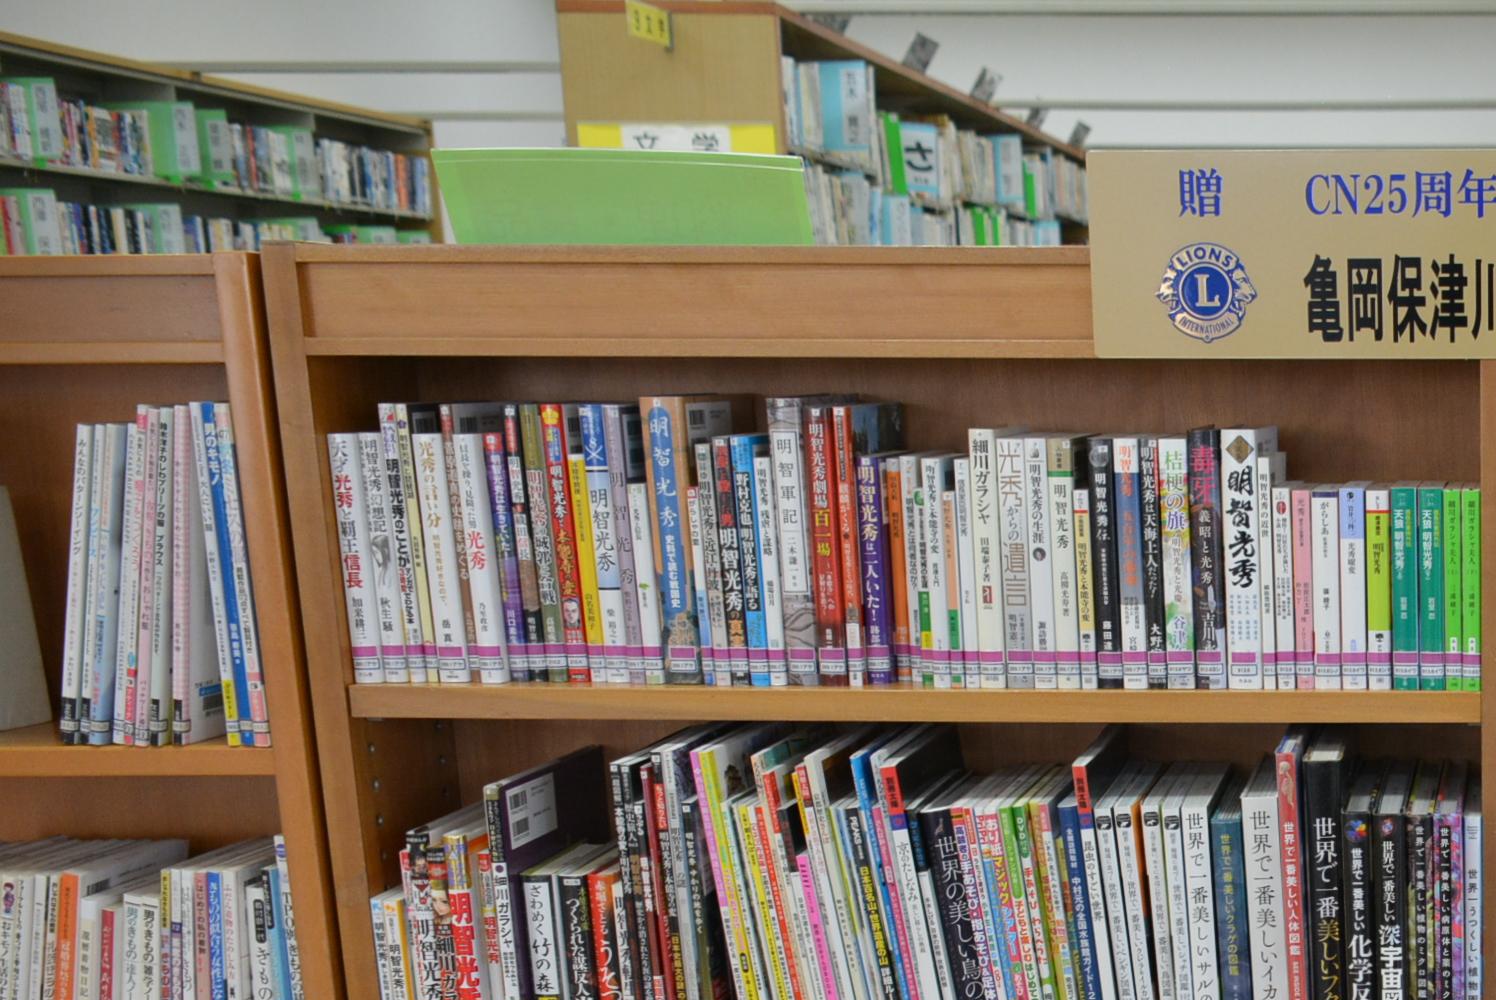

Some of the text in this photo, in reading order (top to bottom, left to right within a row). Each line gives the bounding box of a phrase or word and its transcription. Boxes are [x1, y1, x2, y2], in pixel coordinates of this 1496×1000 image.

[904, 141, 934, 172] さ
[1179, 168, 1224, 217] 贈
[1175, 247, 1234, 269] LIONS
[1194, 273, 1221, 307] L
[1178, 315, 1236, 334] INTERNATIONAL
[649, 417, 678, 528] 明智光秀
[776, 438, 798, 524] 明智軍記
[972, 438, 991, 526] 細川ガラシャ
[590, 489, 616, 573] 明智光秀
[1054, 484, 1068, 550] 明智光秀
